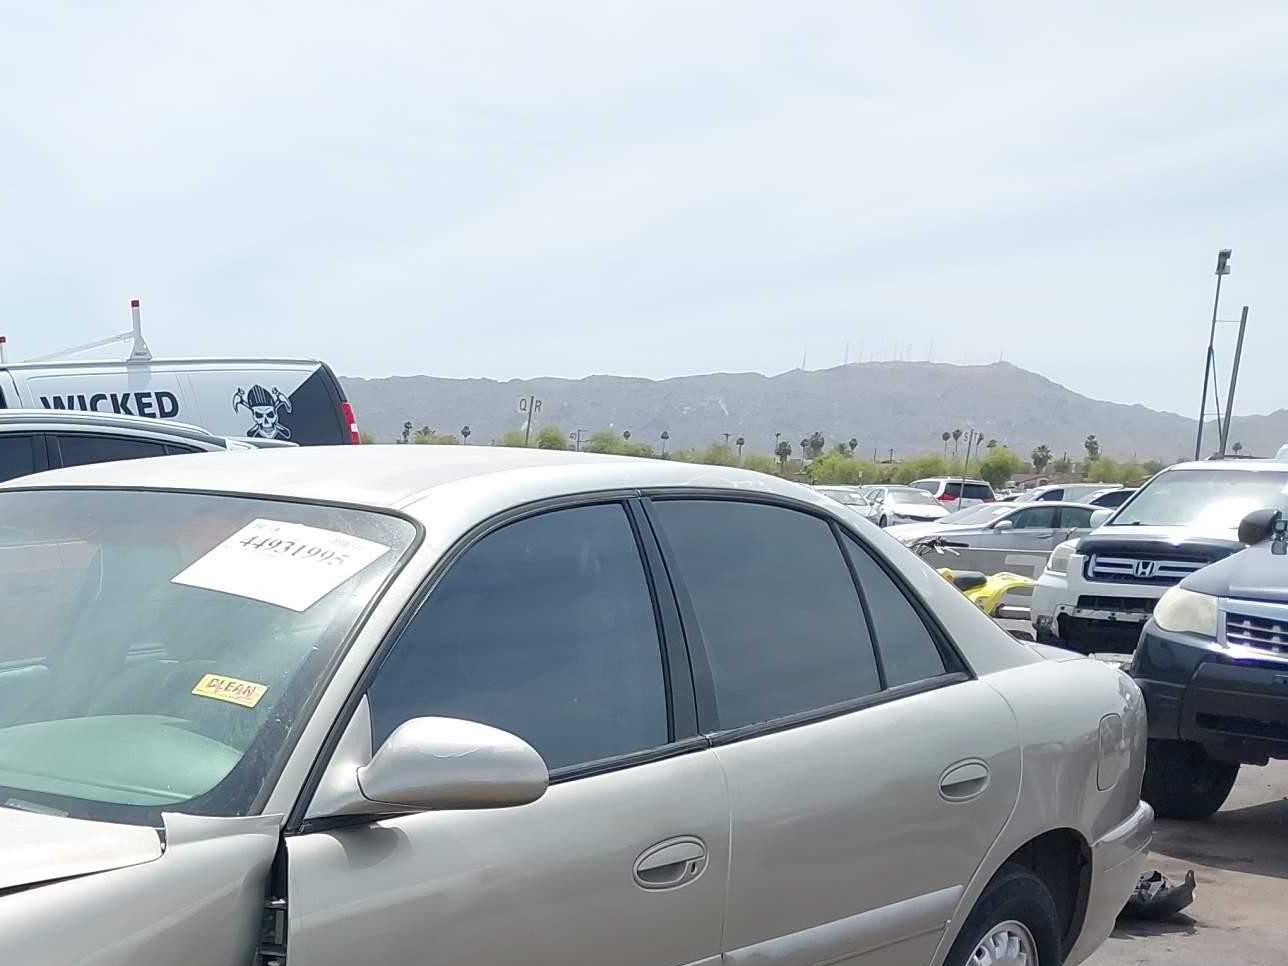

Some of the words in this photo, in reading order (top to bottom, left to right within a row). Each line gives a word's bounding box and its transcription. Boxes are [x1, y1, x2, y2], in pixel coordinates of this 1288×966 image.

[40, 391, 179, 418] WICKED
[519, 398, 527, 411] Q
[534, 400, 542, 412] R
[239, 535, 351, 566] 44931995
